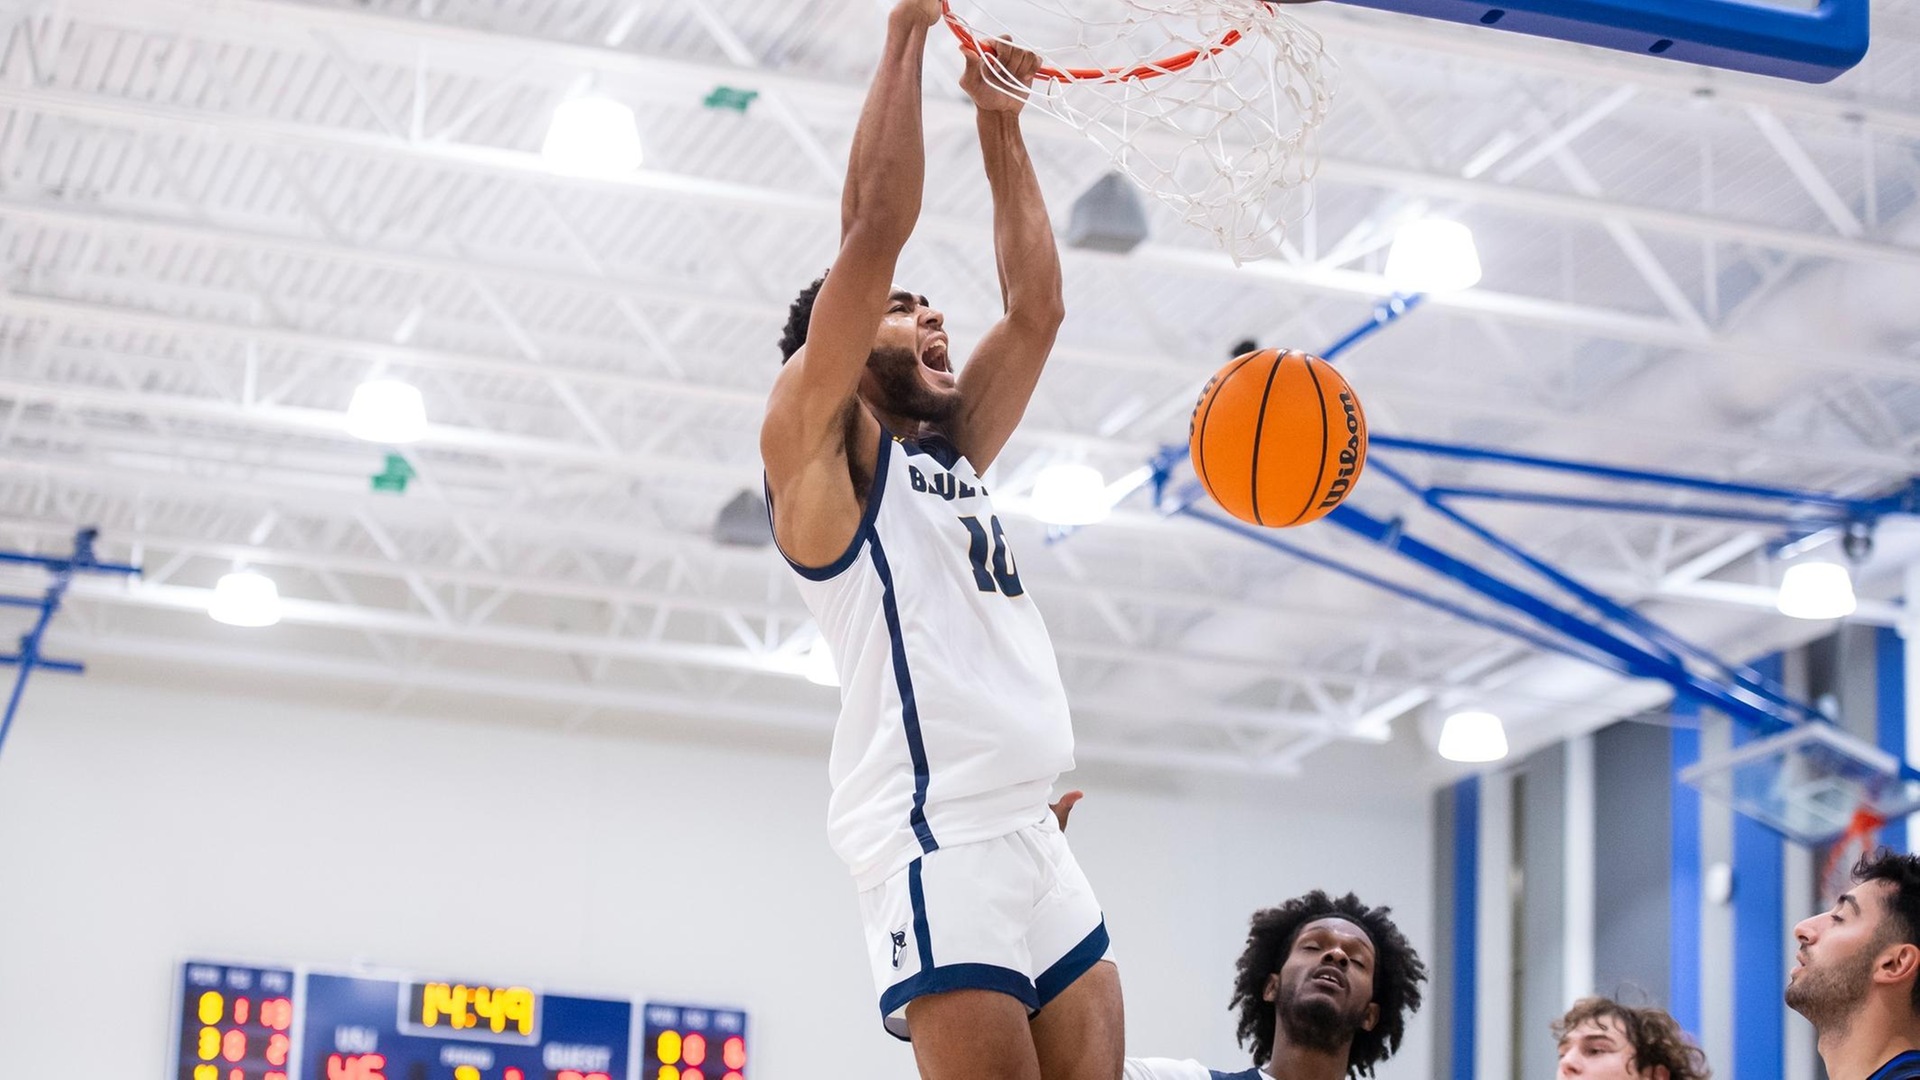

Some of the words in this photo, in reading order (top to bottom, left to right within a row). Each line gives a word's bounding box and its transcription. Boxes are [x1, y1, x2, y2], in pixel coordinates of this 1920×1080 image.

[1318, 387, 1359, 510] Wilson
[957, 514, 1024, 598] 10
[422, 982, 536, 1036] 14:49
